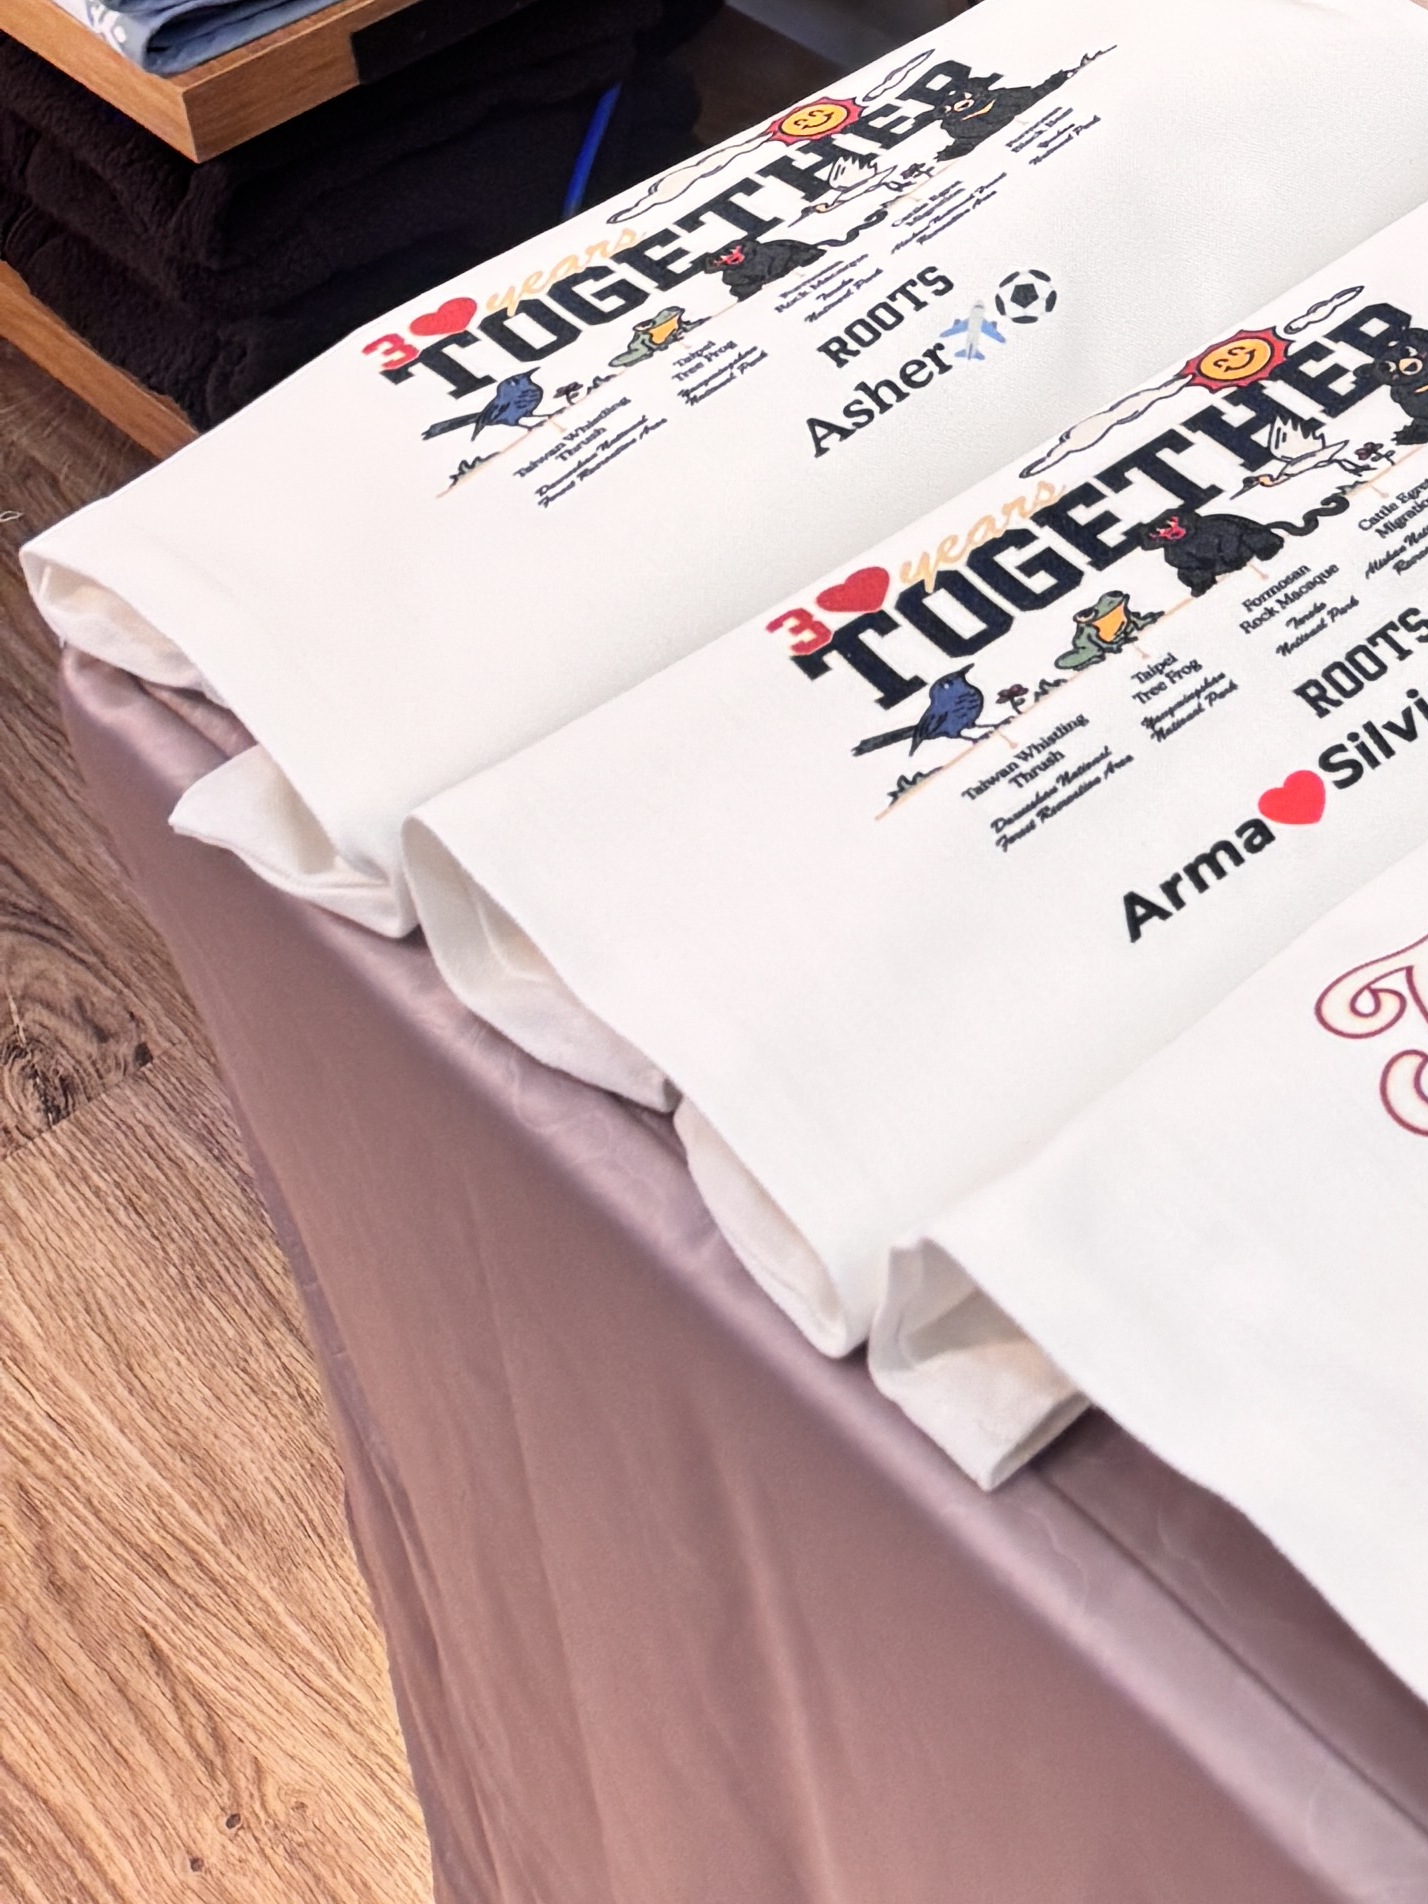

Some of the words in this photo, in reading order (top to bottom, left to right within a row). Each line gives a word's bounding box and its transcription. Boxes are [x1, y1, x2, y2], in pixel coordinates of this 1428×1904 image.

[379, 59, 1003, 402] TOGETHER
[815, 265, 954, 368] ROOTS
[806, 344, 954, 458] Asher
[900, 479, 1068, 594] years
[1008, 750, 1065, 788] Thrush
[1122, 816, 1275, 943] Arma
